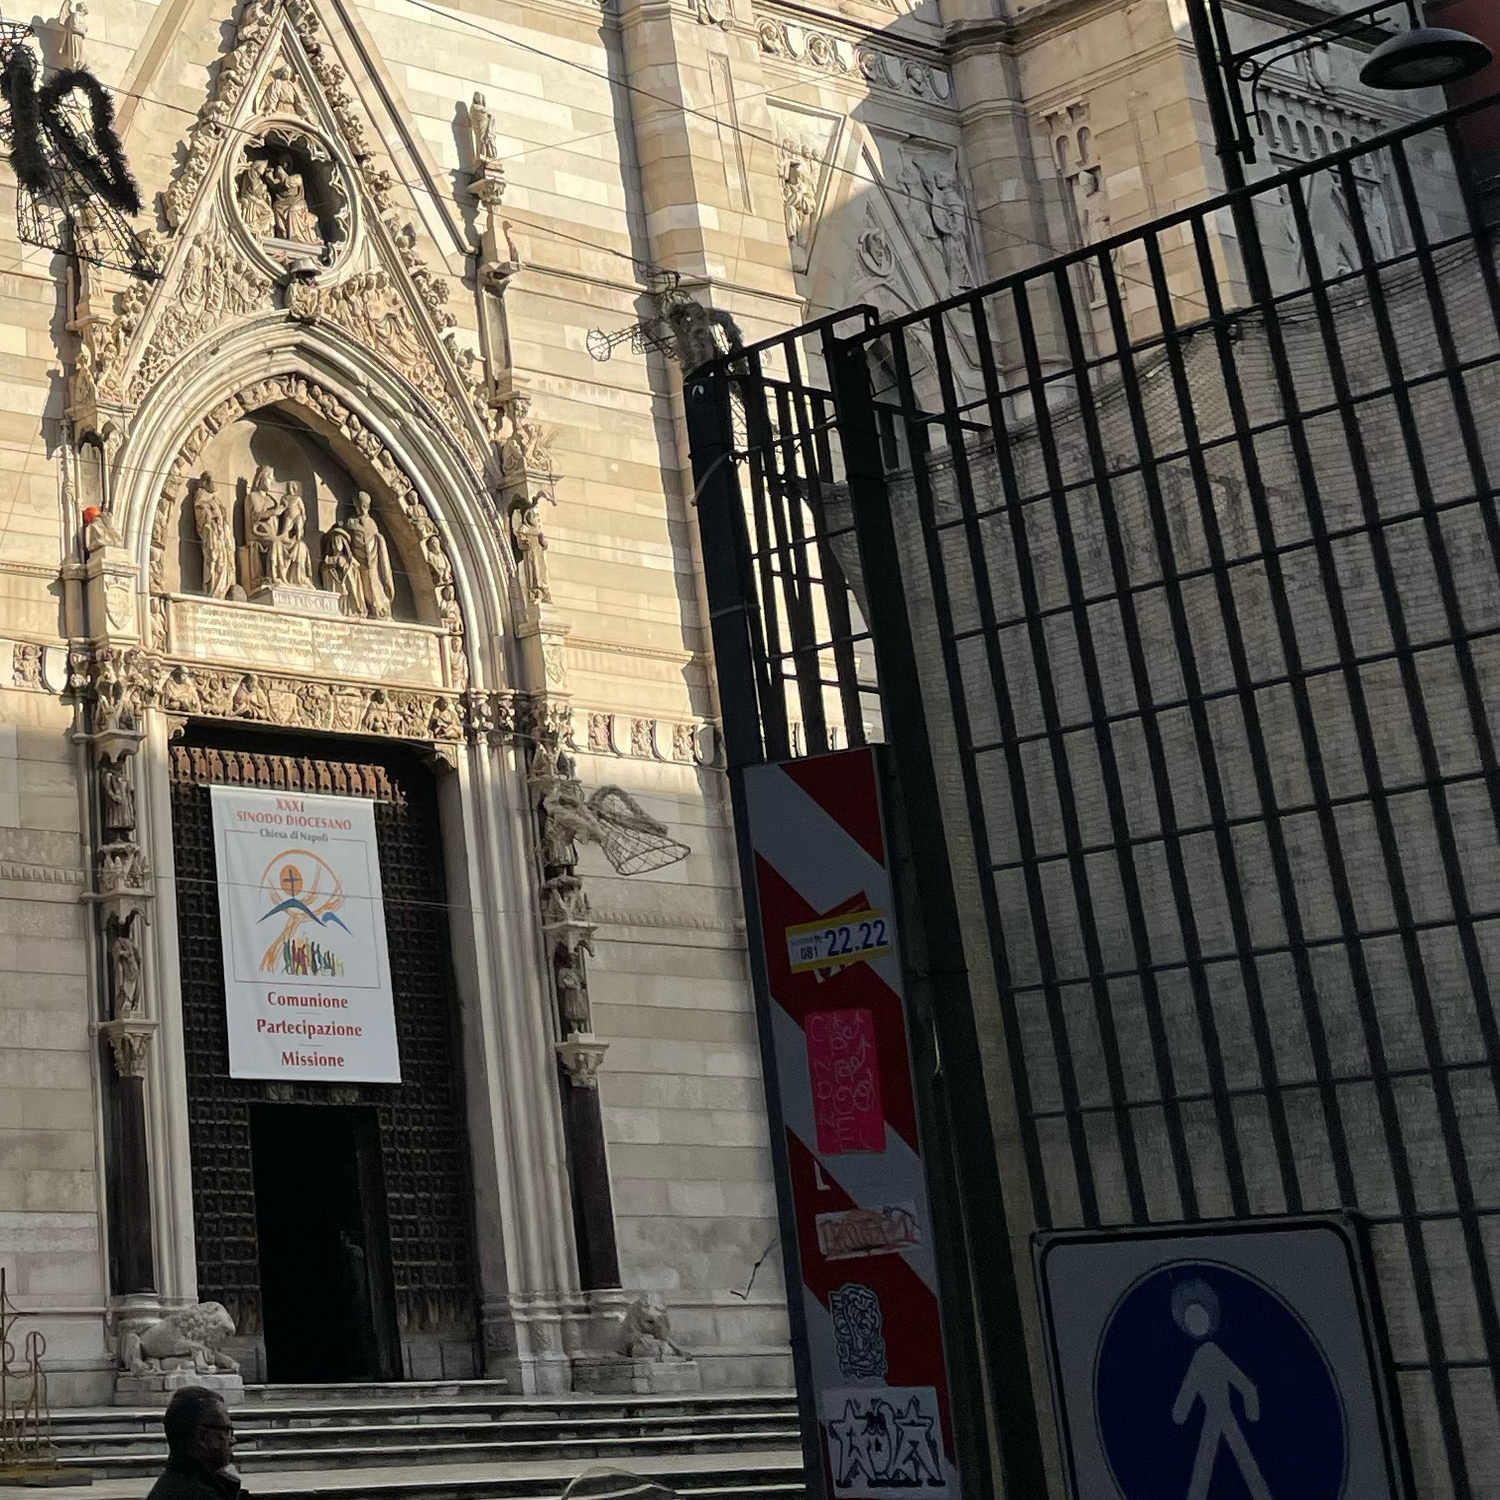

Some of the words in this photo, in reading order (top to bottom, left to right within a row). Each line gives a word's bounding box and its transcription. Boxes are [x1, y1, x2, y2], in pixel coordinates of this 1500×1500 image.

[275, 798, 305, 813] XXXI
[236, 810, 283, 825] SINODO
[285, 815, 352, 831] DIOCESANO
[259, 828, 288, 840] Chiesa
[290, 830, 299, 840] di
[300, 831, 329, 844] Napoli
[824, 918, 889, 957] 22.22
[800, 945, 818, 960] 081
[267, 991, 349, 1009] Comunione
[256, 1018, 363, 1040] Partecipazione
[281, 1051, 345, 1068] Missione
